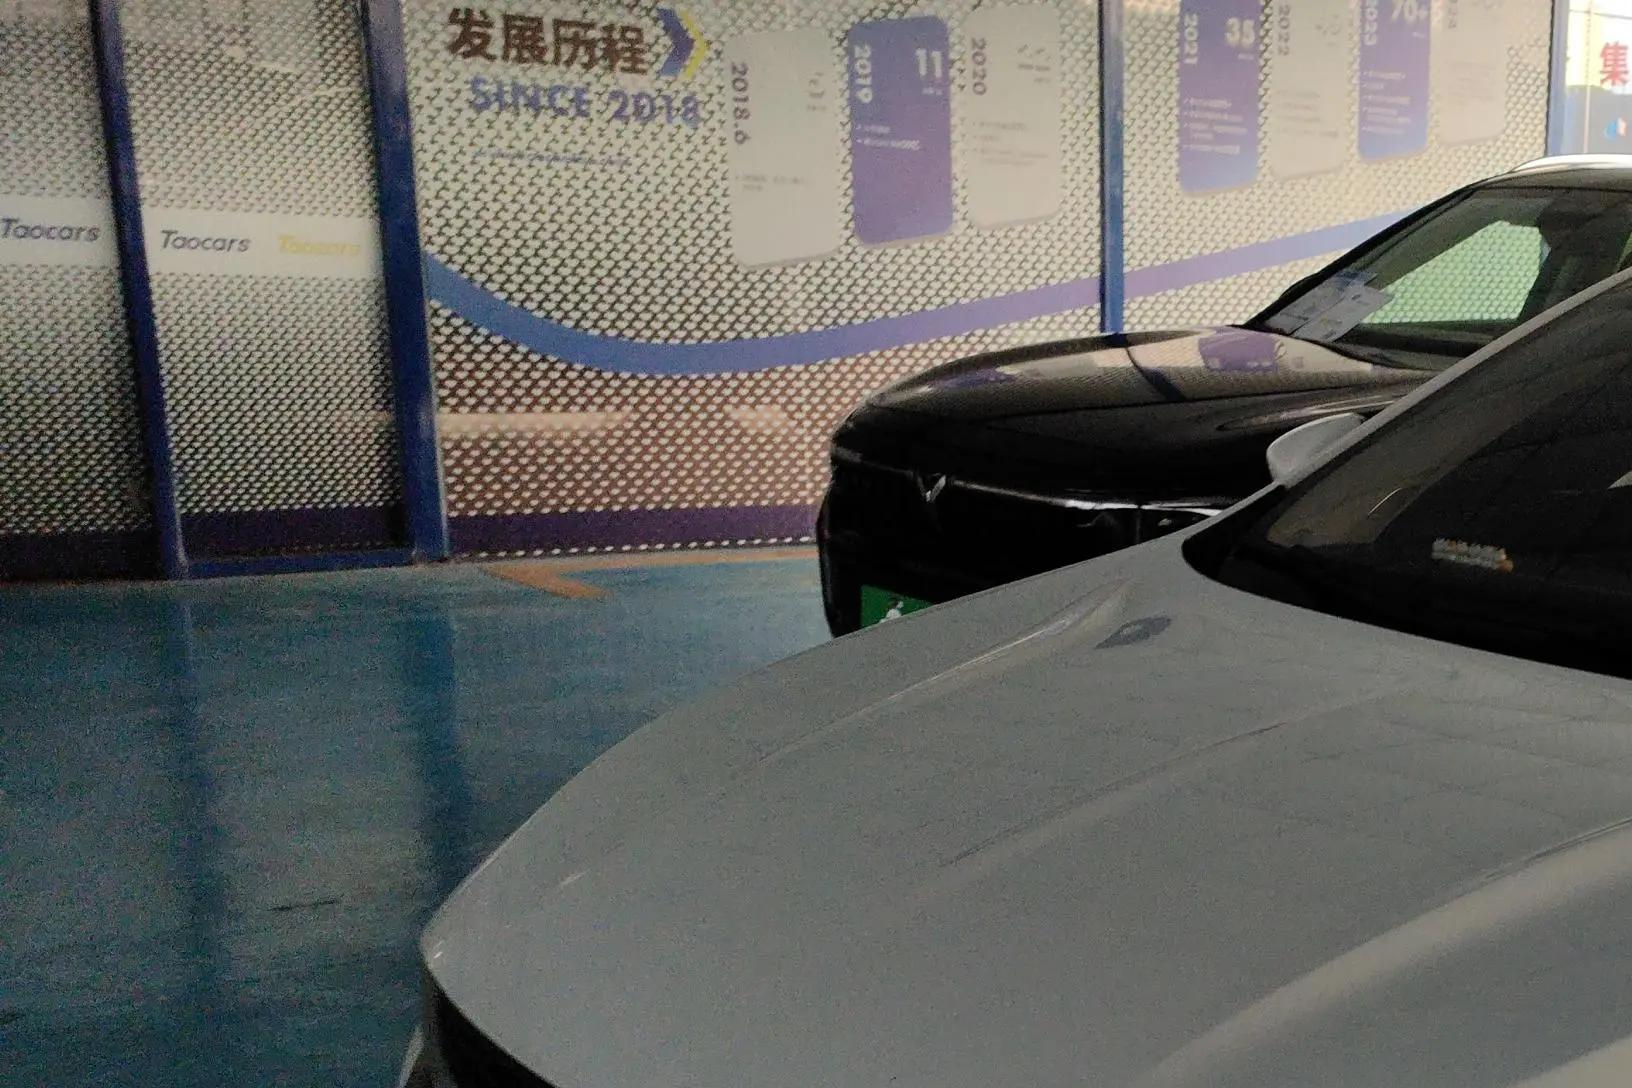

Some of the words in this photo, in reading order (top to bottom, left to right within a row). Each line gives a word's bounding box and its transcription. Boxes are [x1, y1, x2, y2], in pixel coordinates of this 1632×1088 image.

[449, 8, 649, 75] 发展历程
[915, 48, 943, 79] 11
[1184, 14, 1198, 65] 2021
[853, 44, 873, 104] 2019
[971, 37, 987, 96] 2020
[470, 76, 592, 118] SINCE
[608, 89, 701, 127] 2018
[731, 61, 750, 145] 2018.6
[1, 217, 101, 242] Taocars
[160, 229, 252, 252] Taocars
